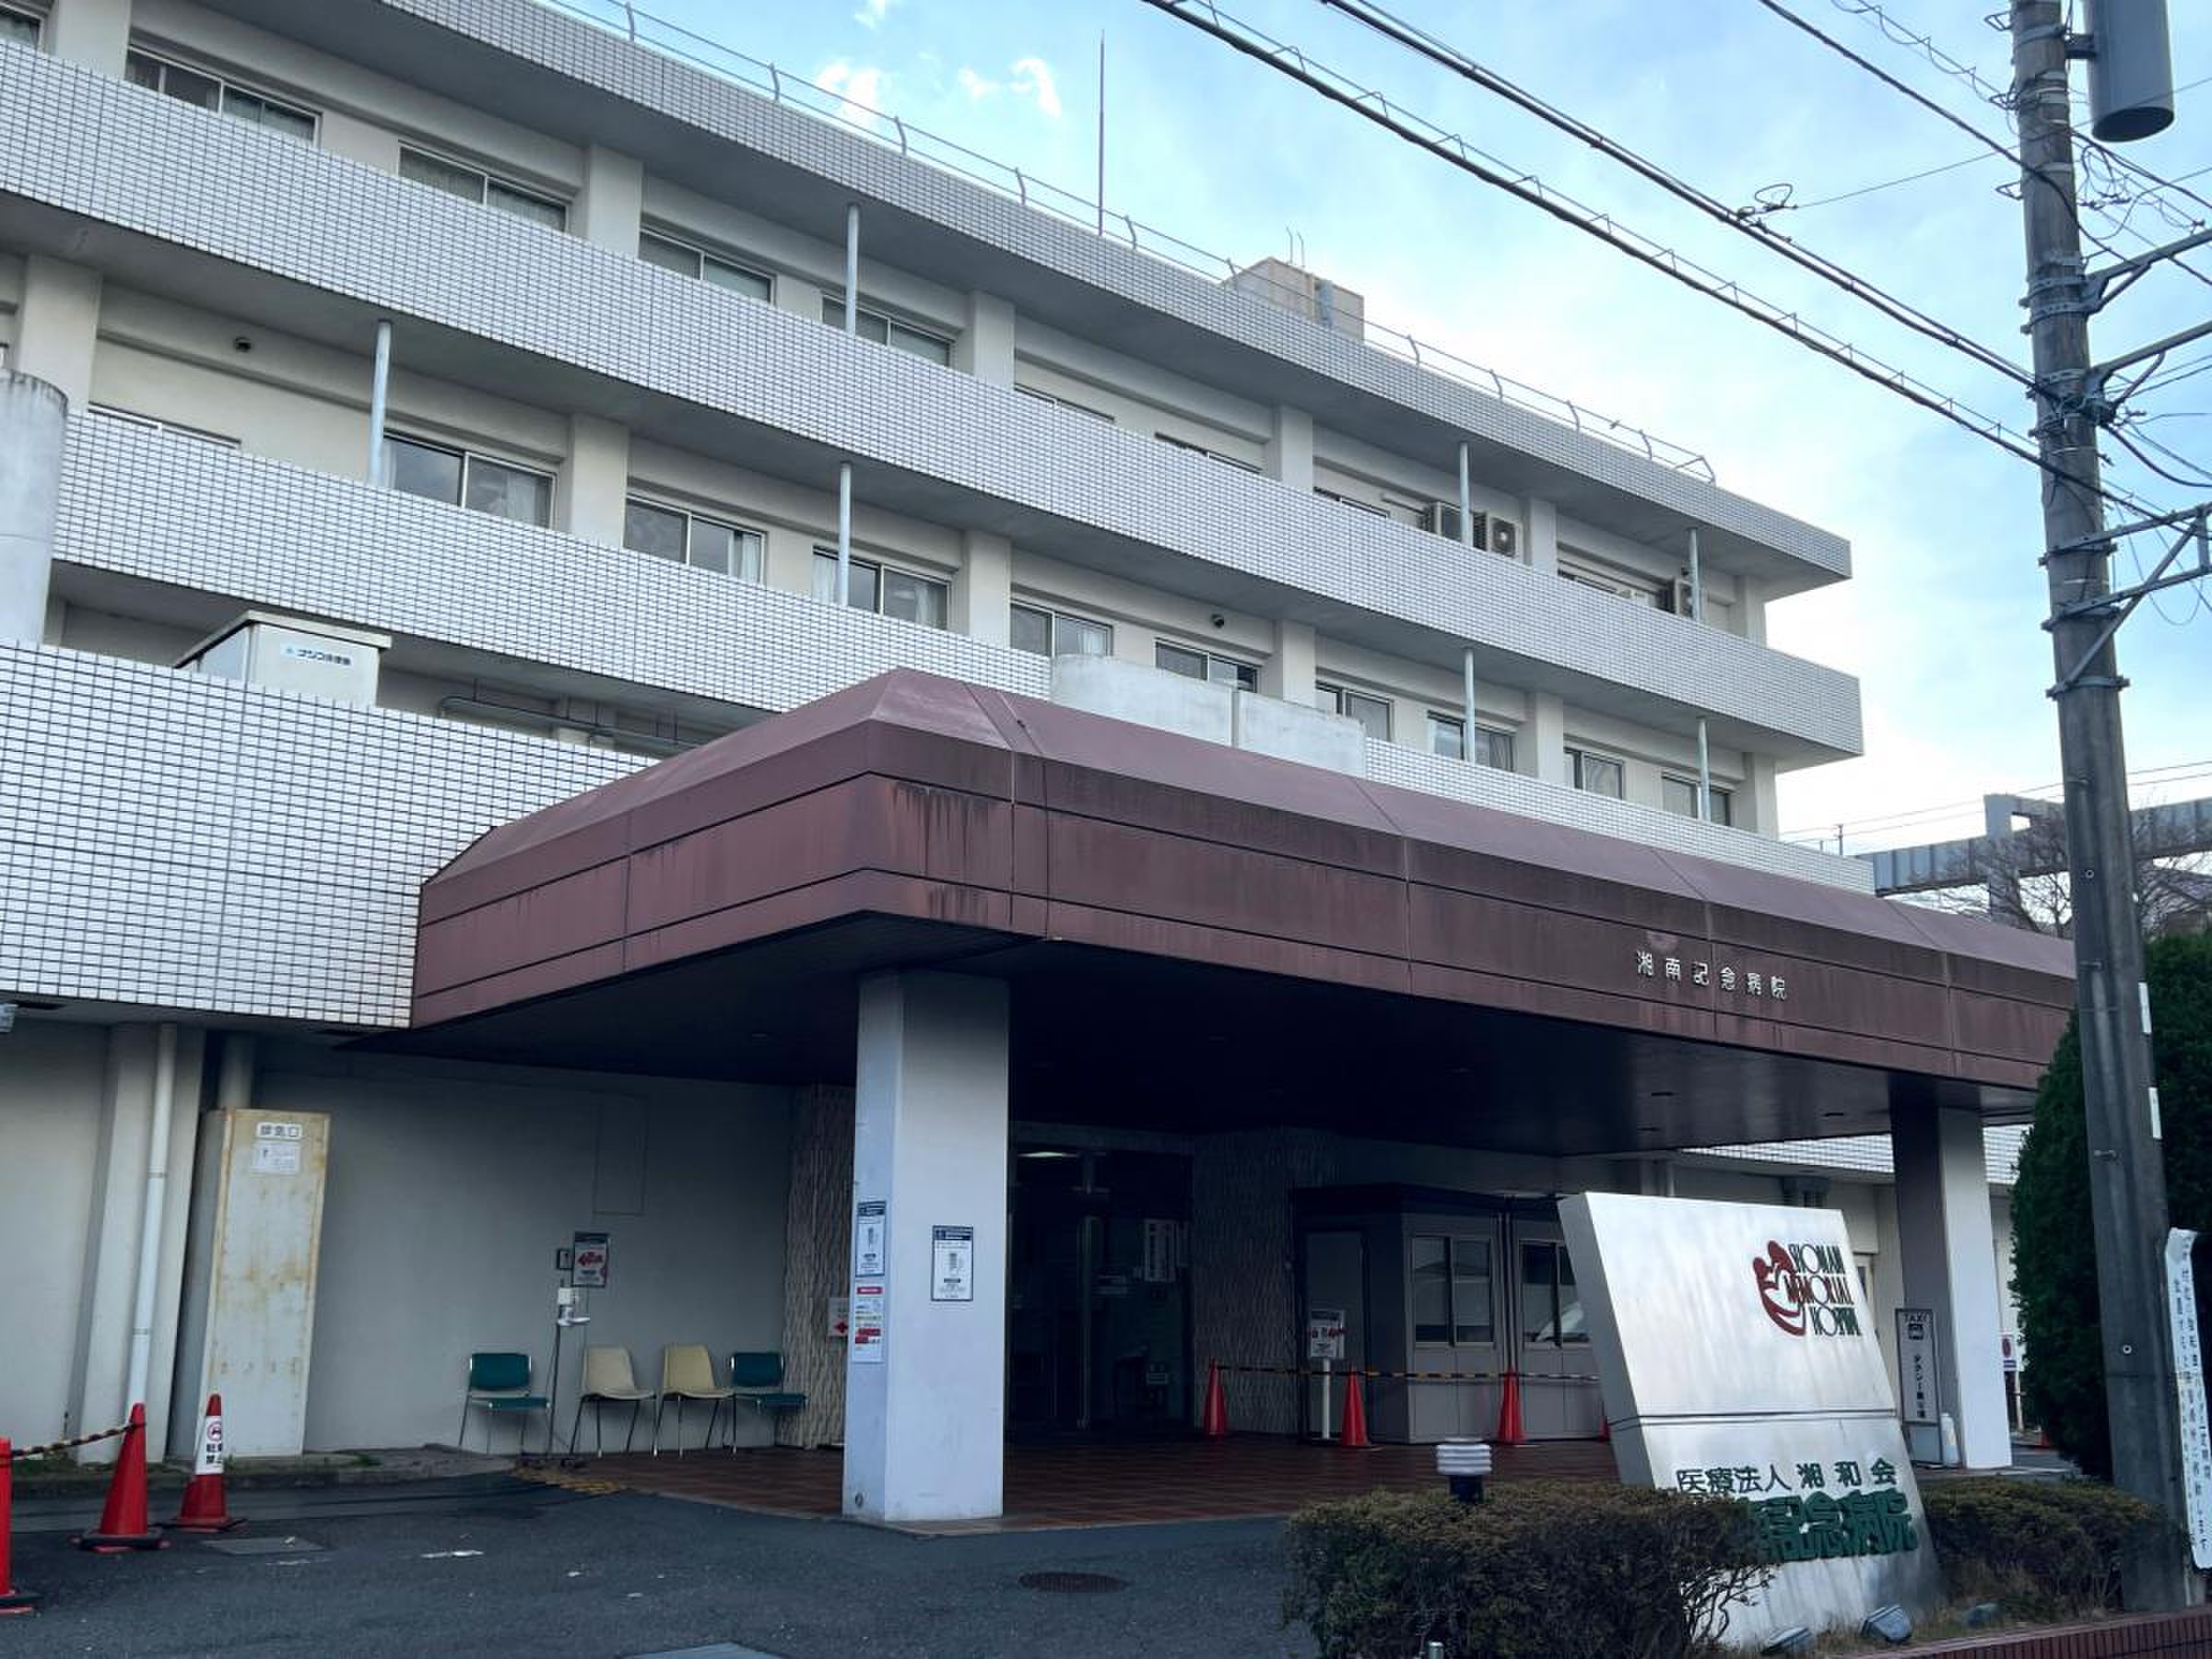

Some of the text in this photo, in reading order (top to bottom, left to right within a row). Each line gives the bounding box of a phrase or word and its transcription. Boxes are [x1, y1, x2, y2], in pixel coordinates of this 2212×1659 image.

[1636, 949, 1787, 1000] 湘南記念病院
[1753, 1488, 1918, 1562] 記念病院
